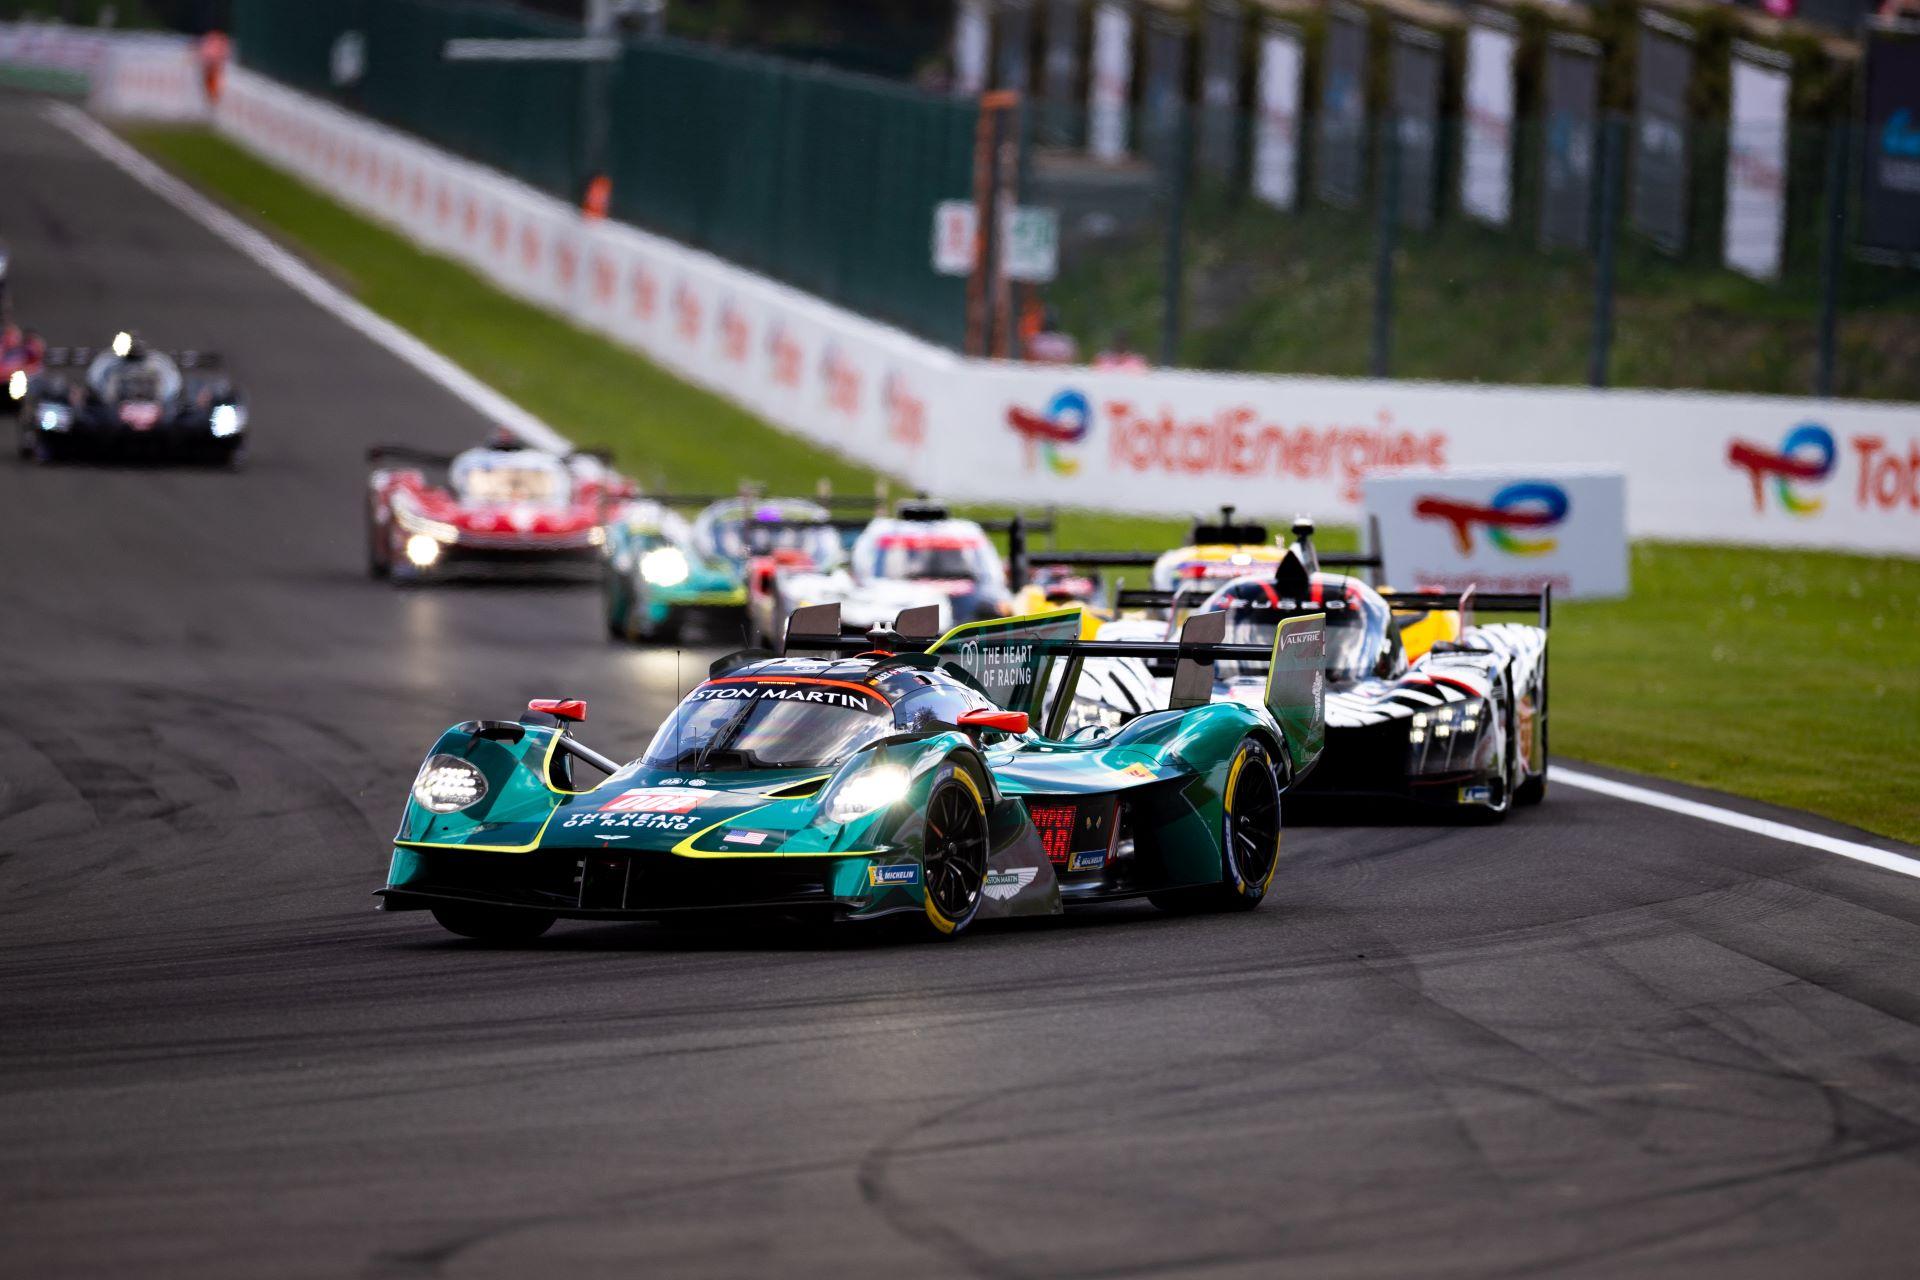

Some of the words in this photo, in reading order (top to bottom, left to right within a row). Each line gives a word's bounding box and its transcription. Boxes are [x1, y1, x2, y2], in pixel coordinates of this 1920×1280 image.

[1107, 402, 1448, 502] TotalEnergies
[1280, 630, 1320, 651] VALKYRIE
[983, 646, 1000, 665] THE
[1003, 645, 1033, 664] HEART
[983, 669, 995, 688] OF
[998, 667, 1032, 687] RACING
[760, 688, 869, 711] MARTIN
[562, 819, 596, 828] OF
[600, 819, 689, 830] RACING
[571, 813, 615, 821] THE
[621, 813, 702, 824] HEART
[1031, 809, 1072, 827] HYPER
[1037, 829, 1068, 856] AR
[884, 870, 915, 880] MICHELIN
